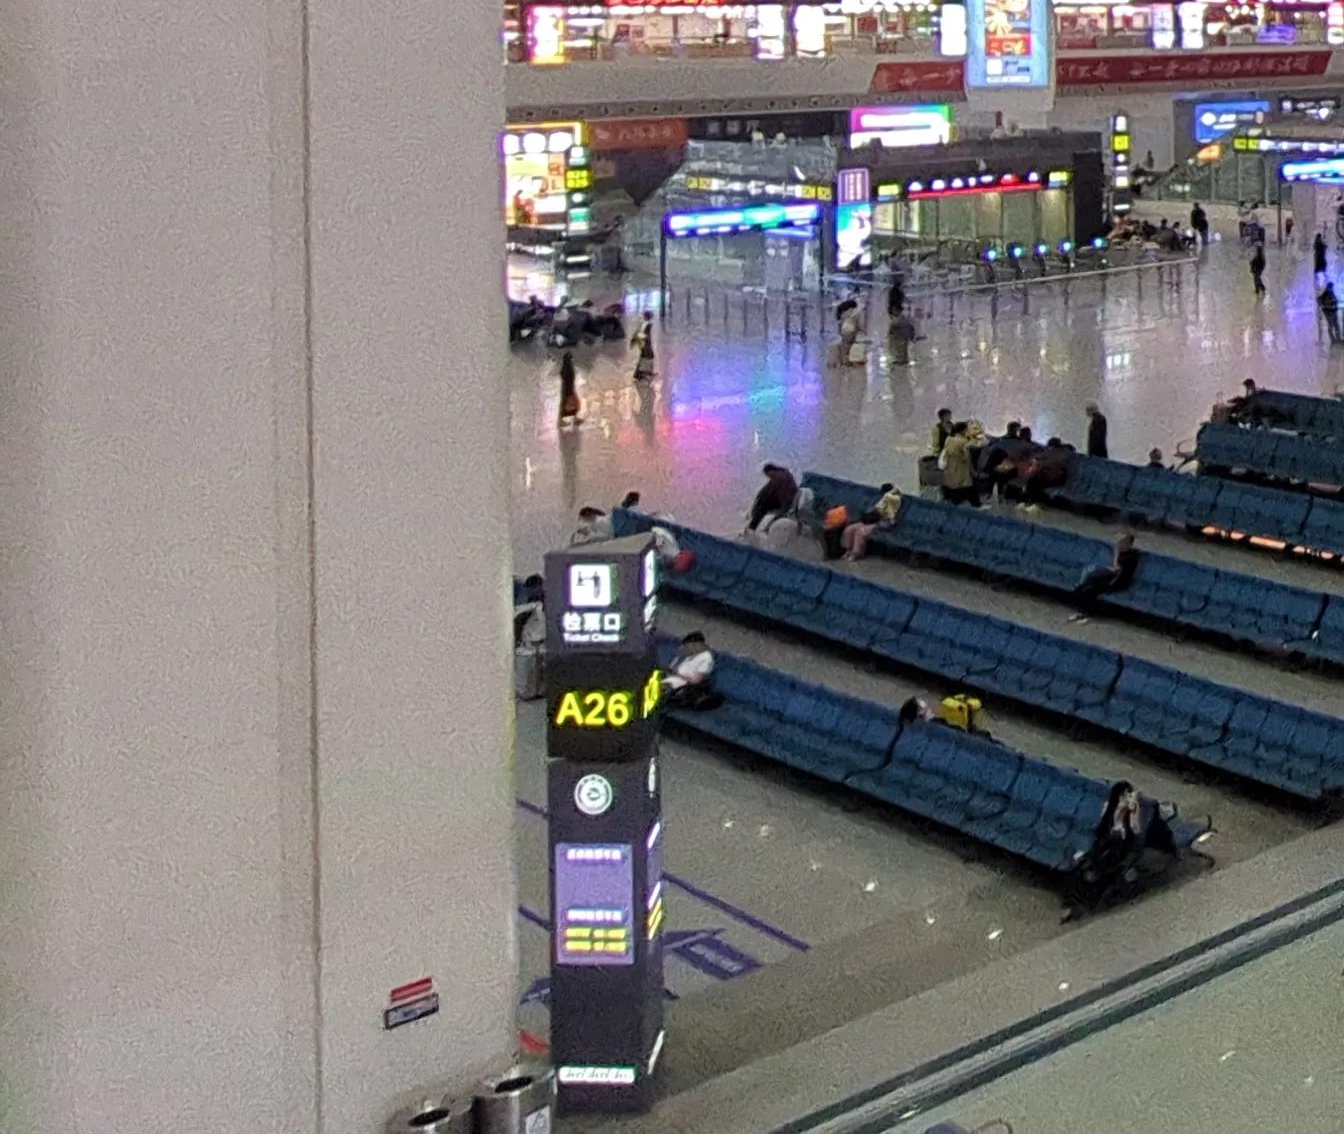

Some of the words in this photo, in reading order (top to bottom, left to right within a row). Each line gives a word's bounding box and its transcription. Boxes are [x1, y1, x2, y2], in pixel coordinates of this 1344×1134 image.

[563, 612, 621, 632] 检票口
[556, 692, 630, 726] A26
